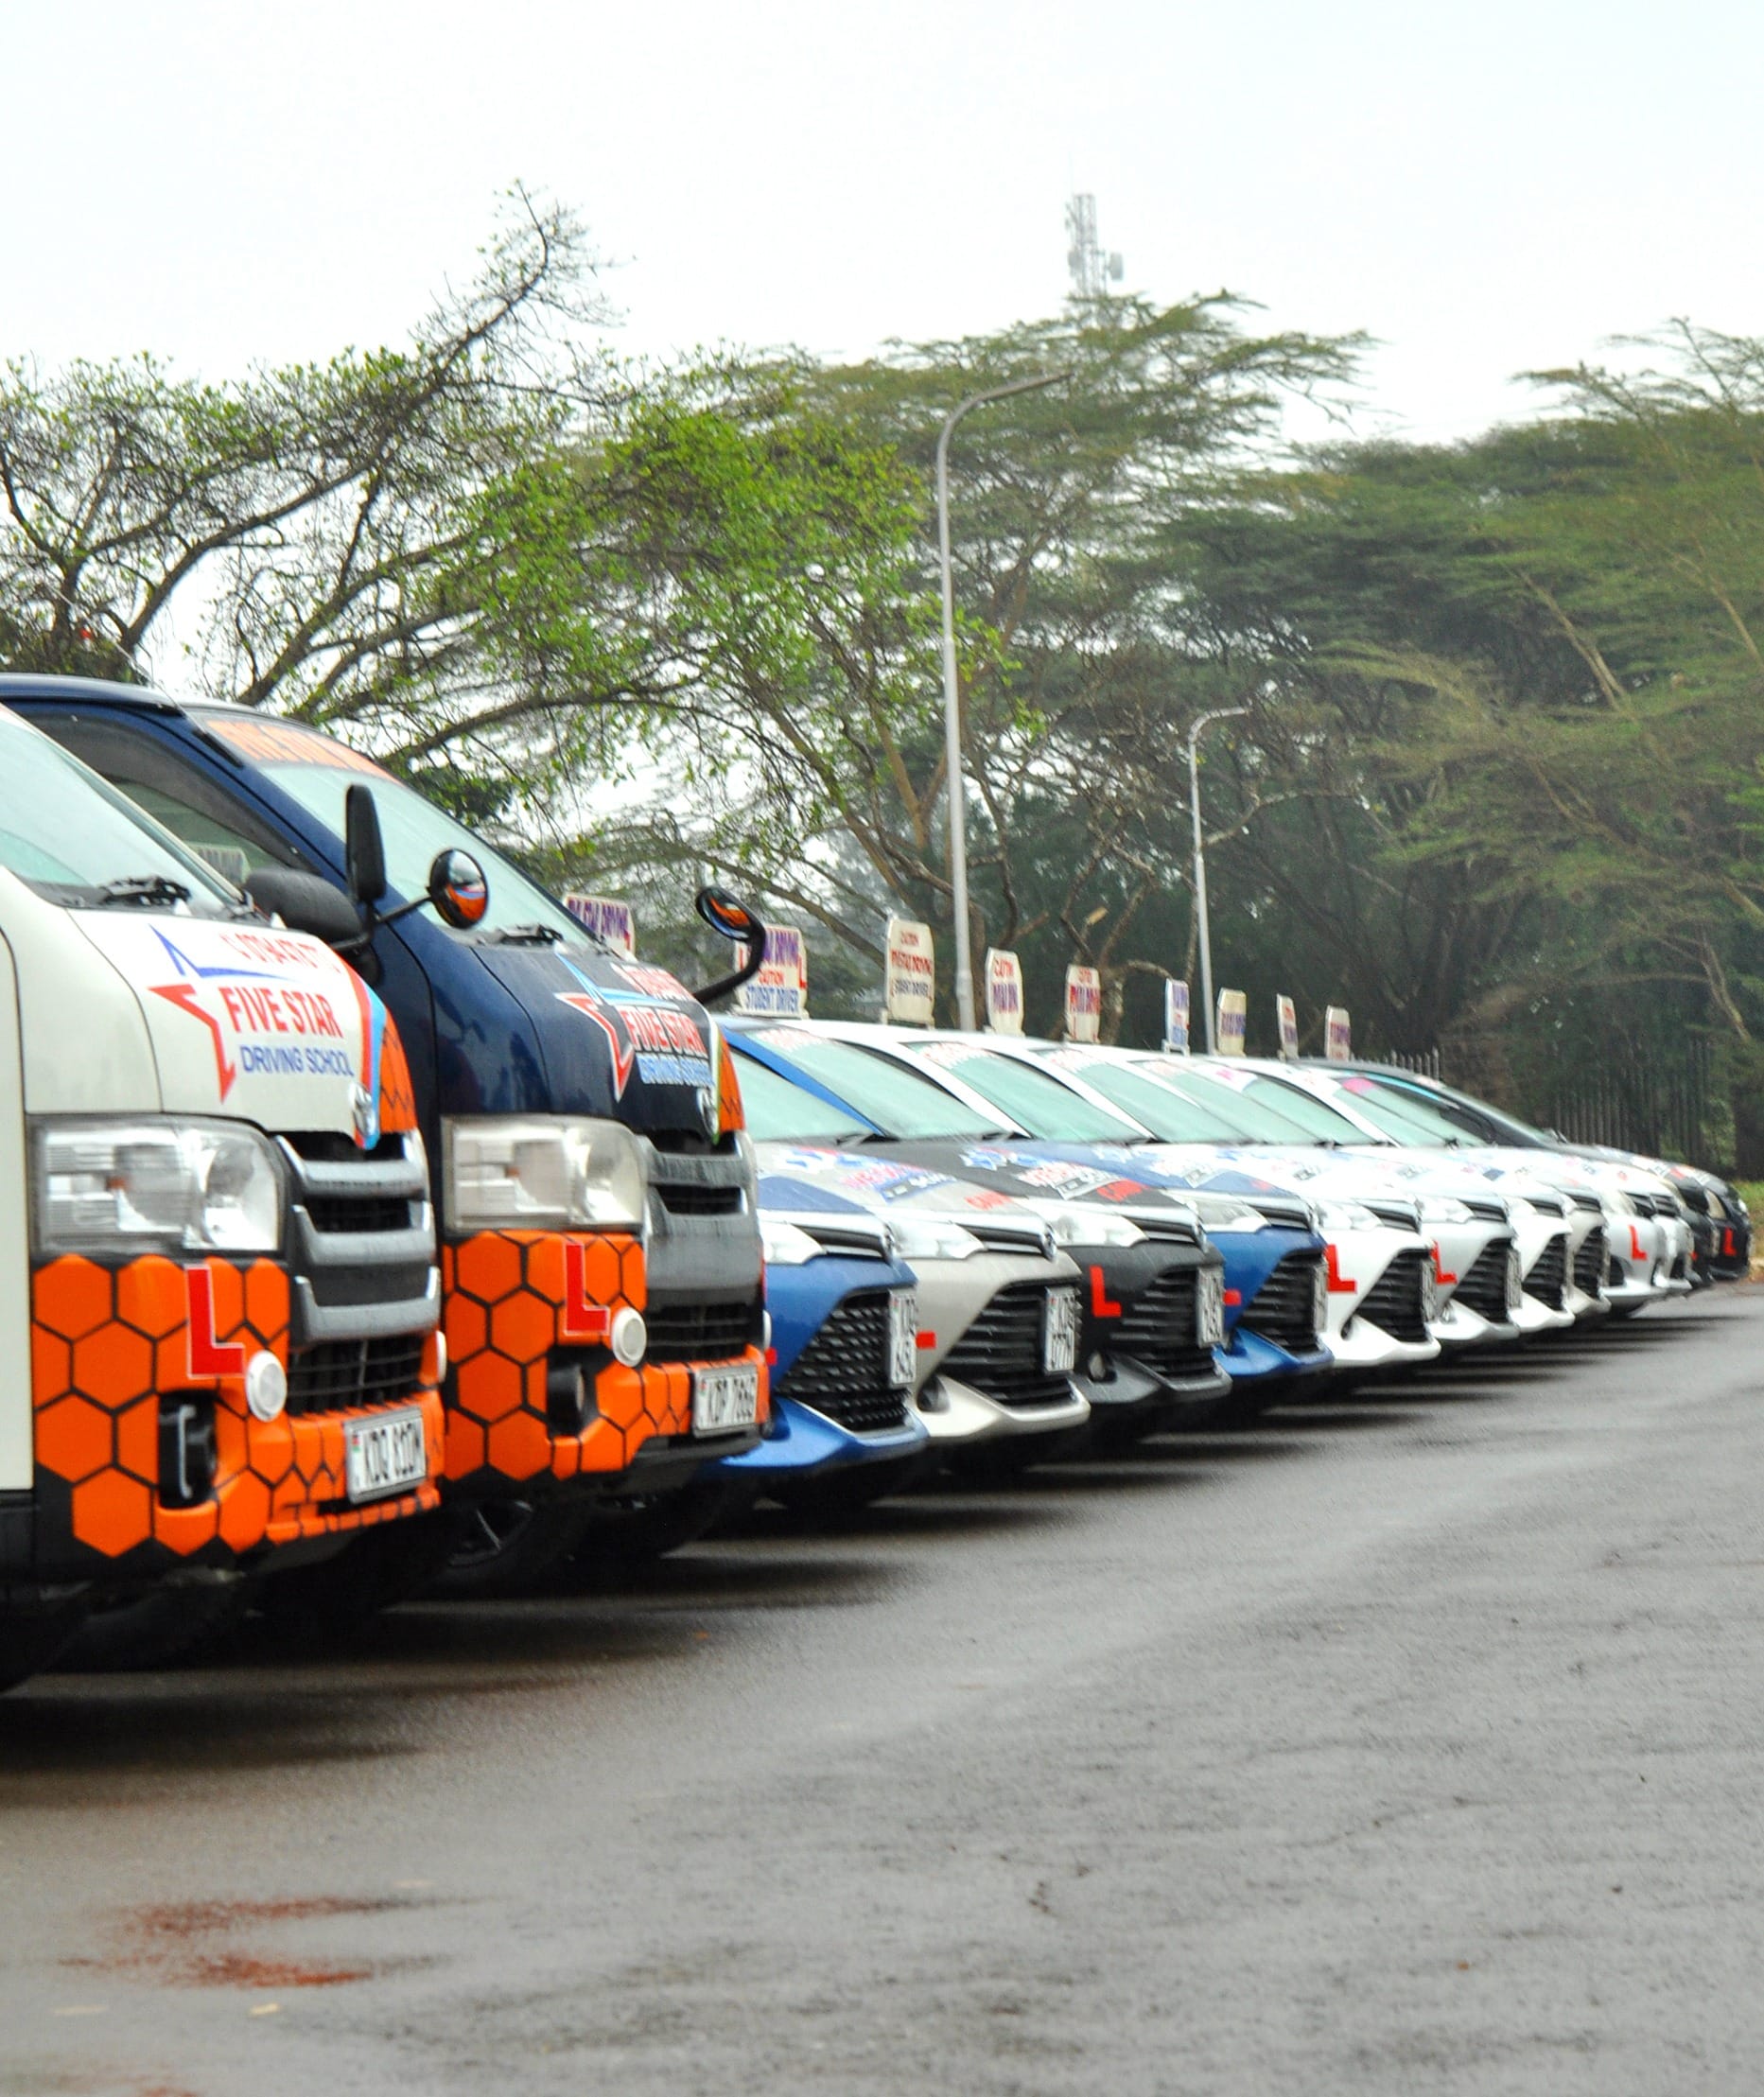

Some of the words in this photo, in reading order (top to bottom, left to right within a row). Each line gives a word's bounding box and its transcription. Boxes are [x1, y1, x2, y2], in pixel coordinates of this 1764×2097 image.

[218, 987, 288, 1033] FIVE
[280, 989, 343, 1039] STAR
[618, 1007, 671, 1050] FIVE
[657, 1010, 707, 1057] STAR
[240, 1045, 303, 1074] DRIVING
[306, 1048, 355, 1077] SCHOOL
[566, 1243, 610, 1336] L
[1090, 1265, 1122, 1318] L
[188, 1266, 245, 1377] L
